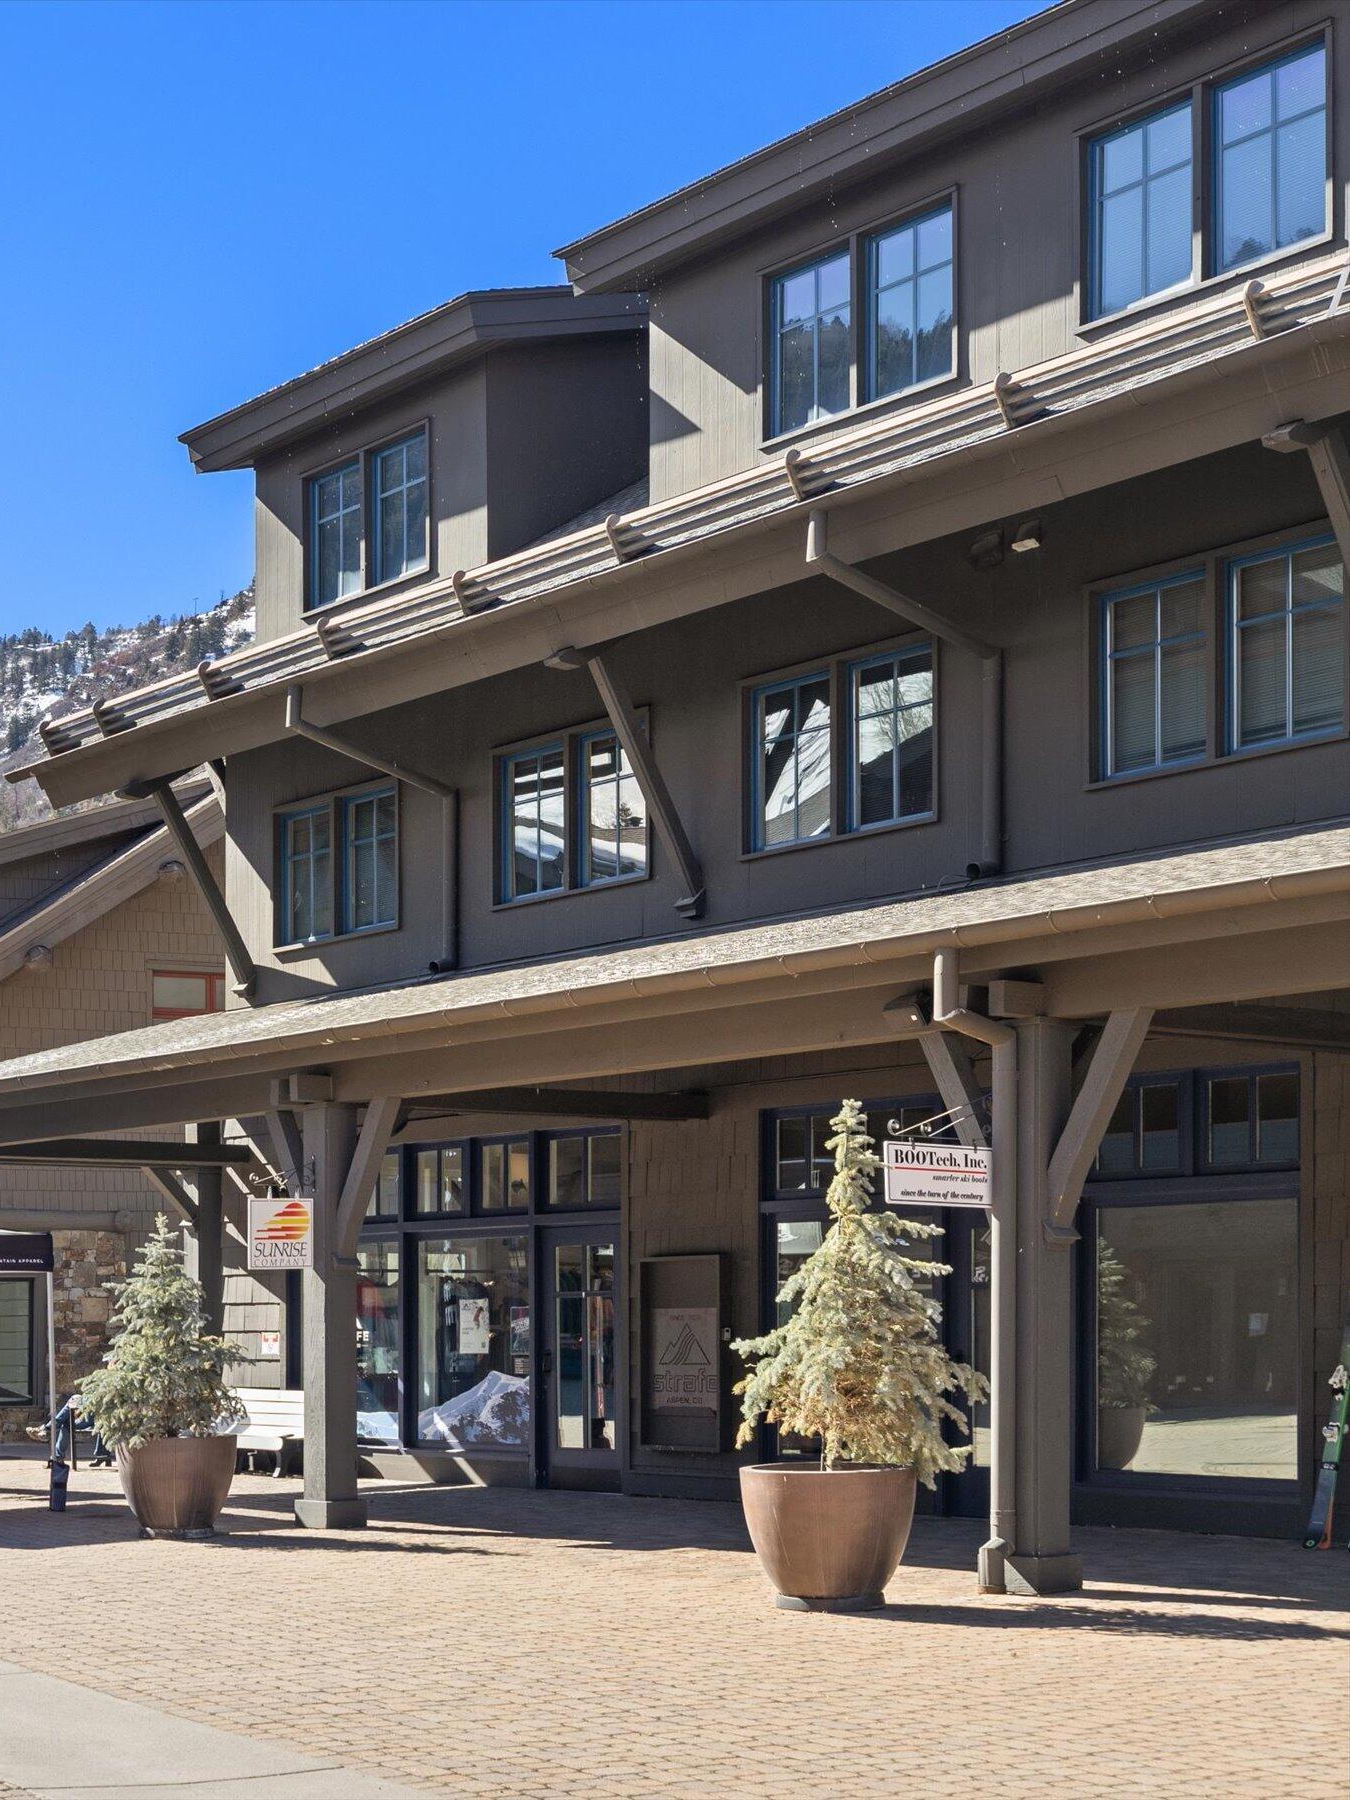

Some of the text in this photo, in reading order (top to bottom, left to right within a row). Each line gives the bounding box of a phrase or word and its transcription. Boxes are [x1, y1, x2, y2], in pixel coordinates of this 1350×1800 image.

[894, 1149, 988, 1169] BOOTech, Inc.
[931, 1174, 988, 1184] smarter ski boots
[900, 1189, 984, 1202] since the turn of the century
[254, 1242, 308, 1258] SUNRISE
[253, 1258, 307, 1267] COMPANY
[653, 1368, 719, 1393] strafe
